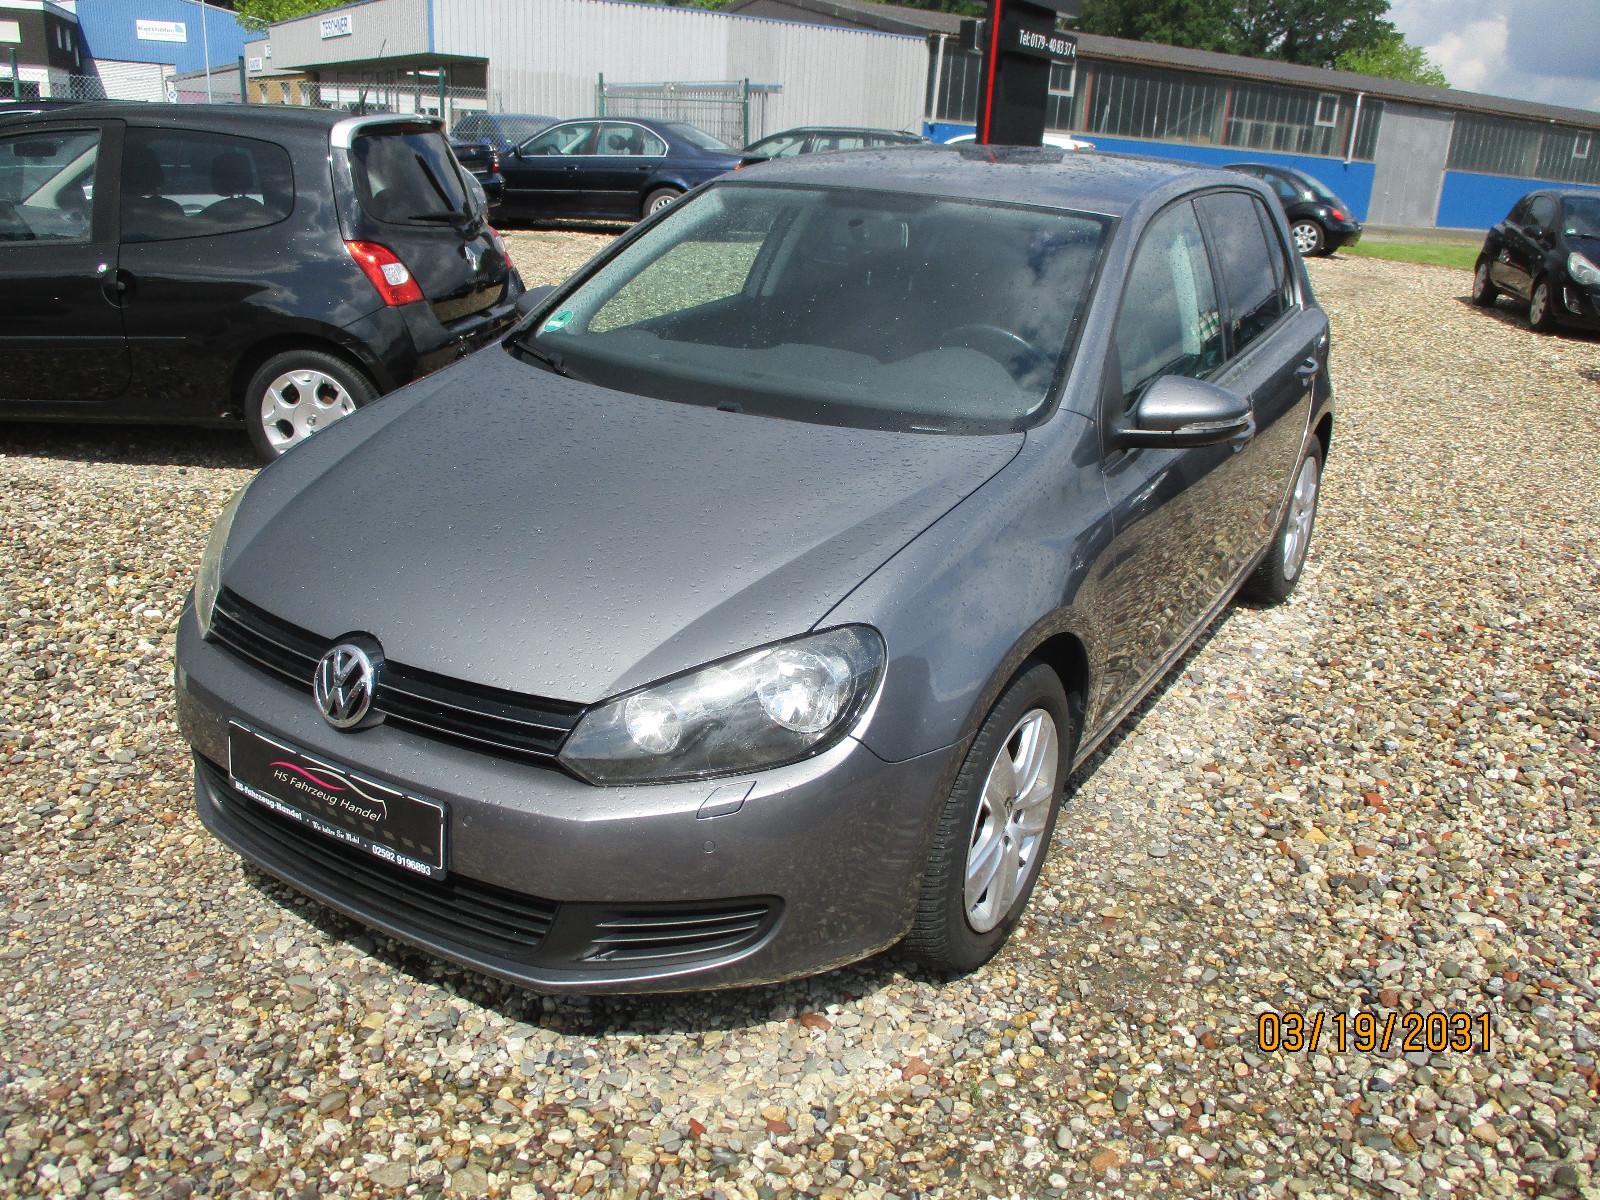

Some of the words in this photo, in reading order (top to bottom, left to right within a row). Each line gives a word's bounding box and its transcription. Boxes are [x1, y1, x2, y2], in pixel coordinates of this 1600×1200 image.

[273, 769, 288, 782] HS
[289, 776, 338, 805] Fahrzeug
[339, 798, 382, 822] Handel
[396, 854, 431, 876] 9196893
